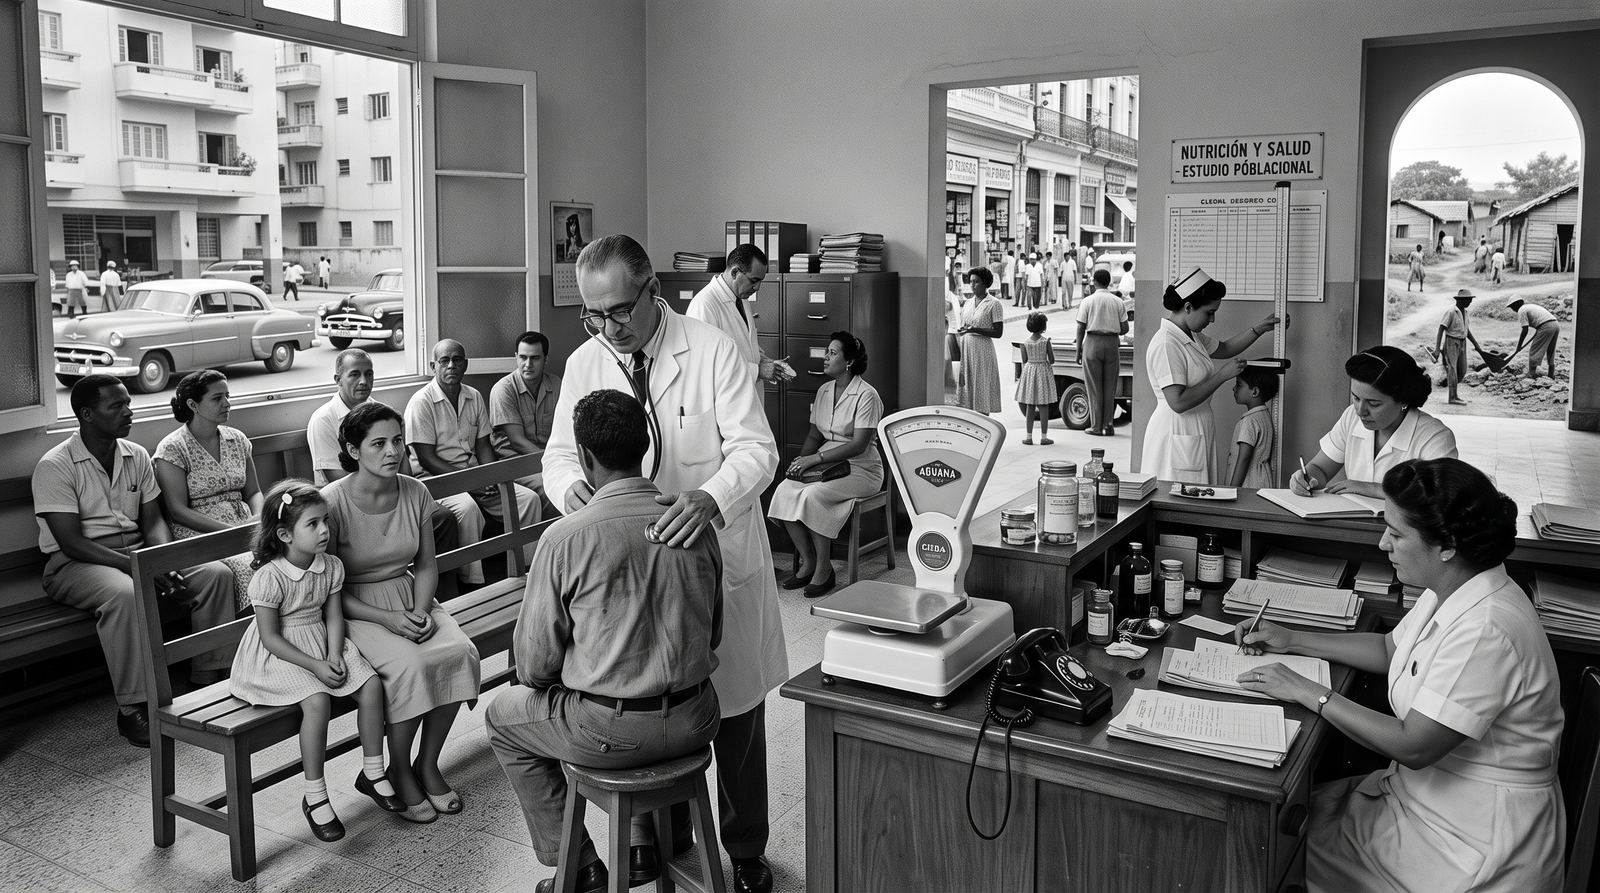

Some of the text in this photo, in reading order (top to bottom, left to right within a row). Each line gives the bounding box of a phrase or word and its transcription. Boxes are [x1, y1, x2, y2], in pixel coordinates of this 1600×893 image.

[1181, 140, 1311, 160] NUTRICIÓN Y SALUD
[1234, 160, 1314, 176] PÓBLACIONAL
[919, 466, 956, 479] AGUANA
